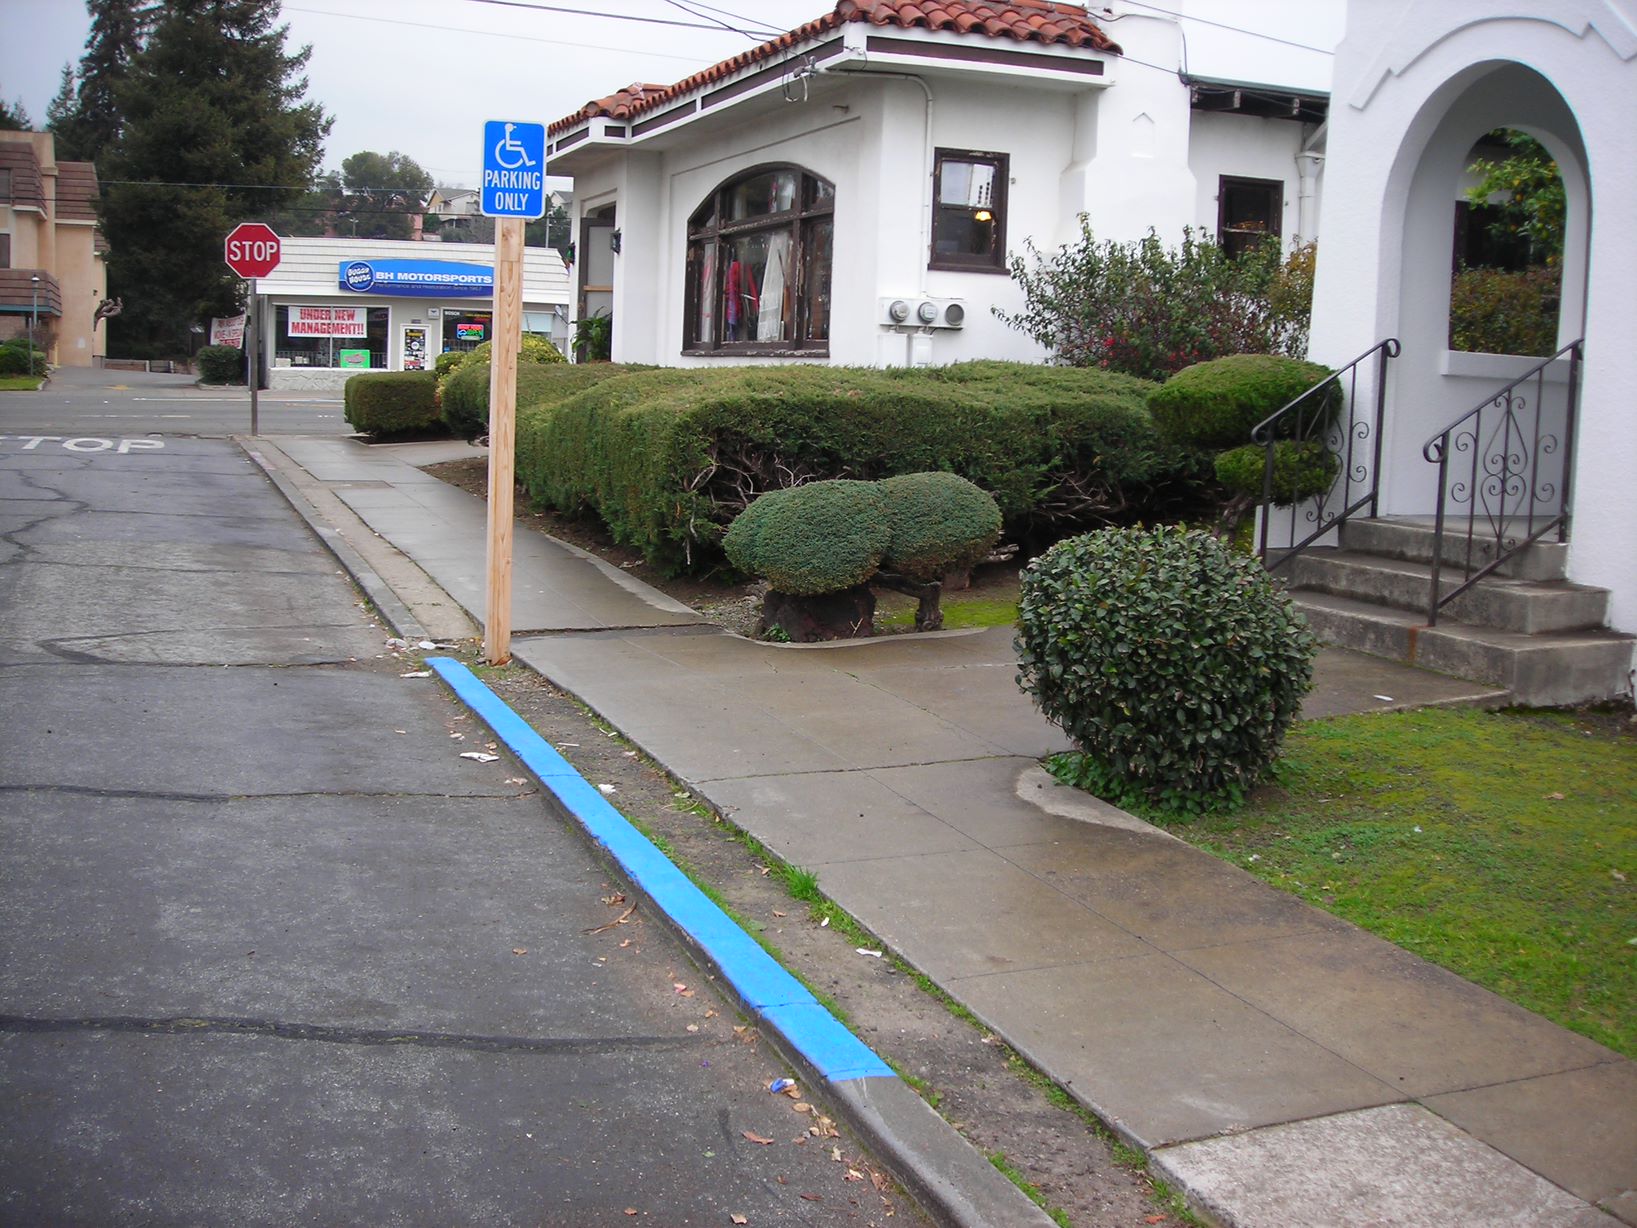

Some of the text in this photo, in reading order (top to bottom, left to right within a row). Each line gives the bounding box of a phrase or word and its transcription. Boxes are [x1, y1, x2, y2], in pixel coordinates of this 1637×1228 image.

[484, 169, 541, 190] PARKING
[495, 191, 529, 211] ONLY
[229, 240, 278, 261] STOP
[375, 271, 492, 284] BH MOTORSPORTS
[299, 308, 356, 321] UNDER NEW
[291, 321, 364, 335] MANAGEMENT!!
